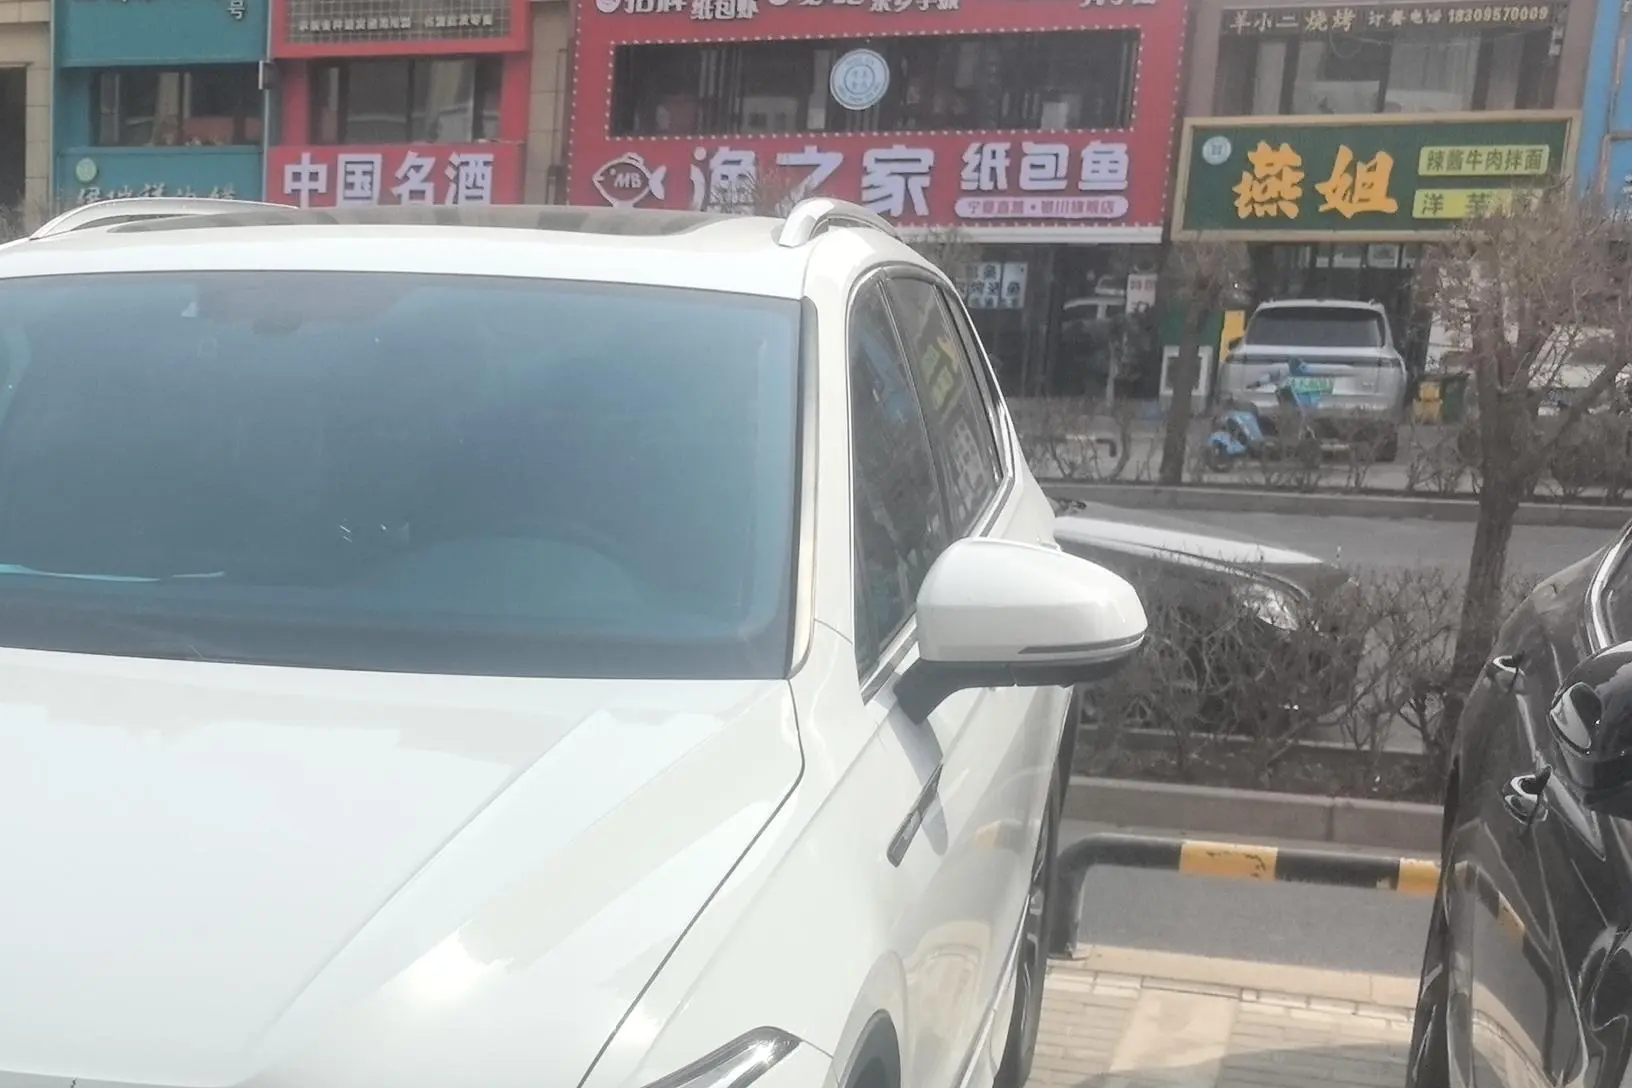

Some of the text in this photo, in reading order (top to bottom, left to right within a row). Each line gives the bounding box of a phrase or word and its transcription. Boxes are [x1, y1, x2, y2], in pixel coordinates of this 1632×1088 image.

[1230, 8, 1355, 35] 羊小二烧烤
[283, 151, 495, 209] 中国名酒
[960, 140, 1129, 191] 纸包鱼
[1231, 140, 1399, 220] 燕姐
[1426, 147, 1544, 172] 辣酱牛肉拌面
